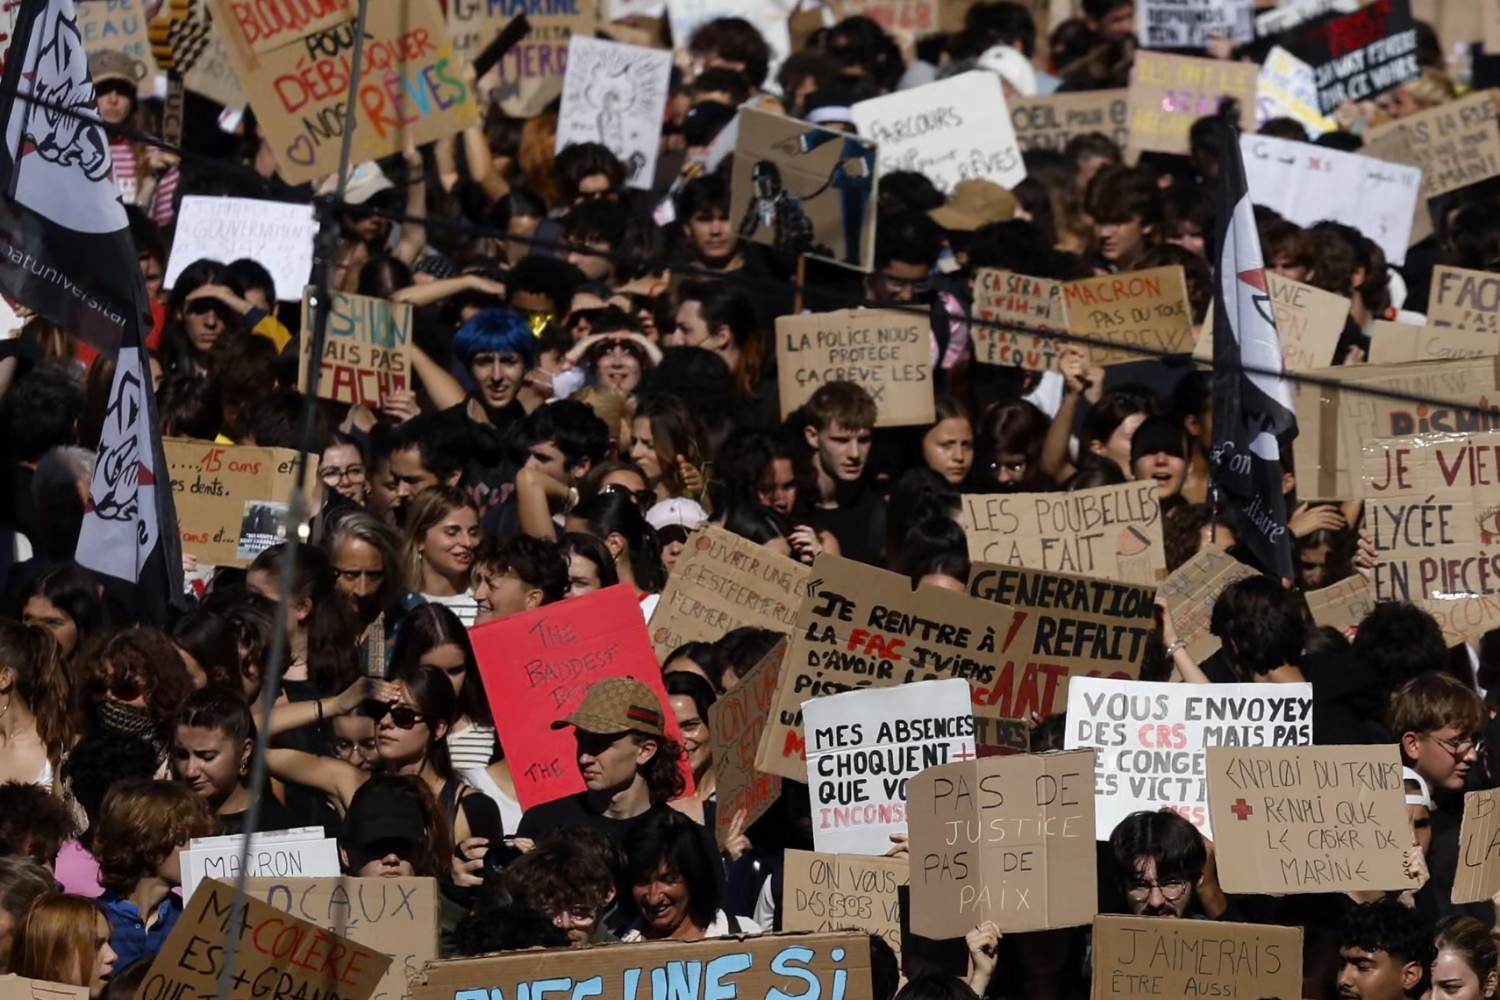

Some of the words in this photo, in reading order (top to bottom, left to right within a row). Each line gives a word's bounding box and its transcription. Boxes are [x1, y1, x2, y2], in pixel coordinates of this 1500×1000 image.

[1063, 277, 1162, 308] MACRON
[1088, 309, 1126, 329] PAS
[786, 333, 811, 352] LA
[817, 326, 870, 348] POLICE
[878, 326, 919, 343] NOUS
[370, 348, 405, 372] PAS
[892, 364, 927, 382] LES
[200, 448, 225, 472] 15
[228, 459, 262, 474] ans
[1370, 448, 1412, 491] JE
[969, 498, 1019, 535] LES
[1034, 486, 1160, 534] POUBELLES
[1373, 495, 1455, 551] LYCÉE
[1040, 533, 1105, 573] FAIT
[970, 570, 1157, 619] GENERATION
[1373, 560, 1409, 600] EN
[528, 616, 577, 649] THE
[811, 590, 856, 622] JE
[868, 605, 969, 648] RENTRE
[976, 627, 995, 653] À
[804, 621, 837, 645] LA
[847, 628, 906, 661] FAC
[1031, 615, 1148, 664] REFAIT
[525, 644, 618, 688] BADDEST
[807, 650, 894, 680] D'AVOIR
[908, 646, 995, 685] J'VIENS
[1082, 692, 1169, 722] VOUS
[814, 725, 864, 750] MES
[876, 713, 975, 746] ABSENCES
[1078, 719, 1127, 747] DES
[1138, 723, 1189, 749] CRS
[1201, 724, 1266, 748] MAIS
[1274, 724, 1311, 746] PAS
[525, 759, 564, 782] THE
[816, 742, 952, 777] CHOQUENT
[1314, 759, 1339, 790] DU
[819, 777, 871, 806] QUE
[933, 775, 1004, 814] PAS
[1036, 771, 1081, 808] DE
[944, 813, 1082, 847] JUSTICE
[1335, 801, 1381, 827] QUE
[1266, 829, 1292, 853] LE
[1307, 825, 1365, 850] CASIER
[1375, 829, 1400, 850] DE
[923, 851, 969, 886] PAS
[1003, 850, 1034, 873] DE
[1280, 853, 1370, 885] MARINE
[828, 892, 872, 919] SOS
[959, 885, 1033, 912] PAIX
[252, 917, 372, 987] COLÈRE
[1111, 969, 1164, 995] ÊTRE
